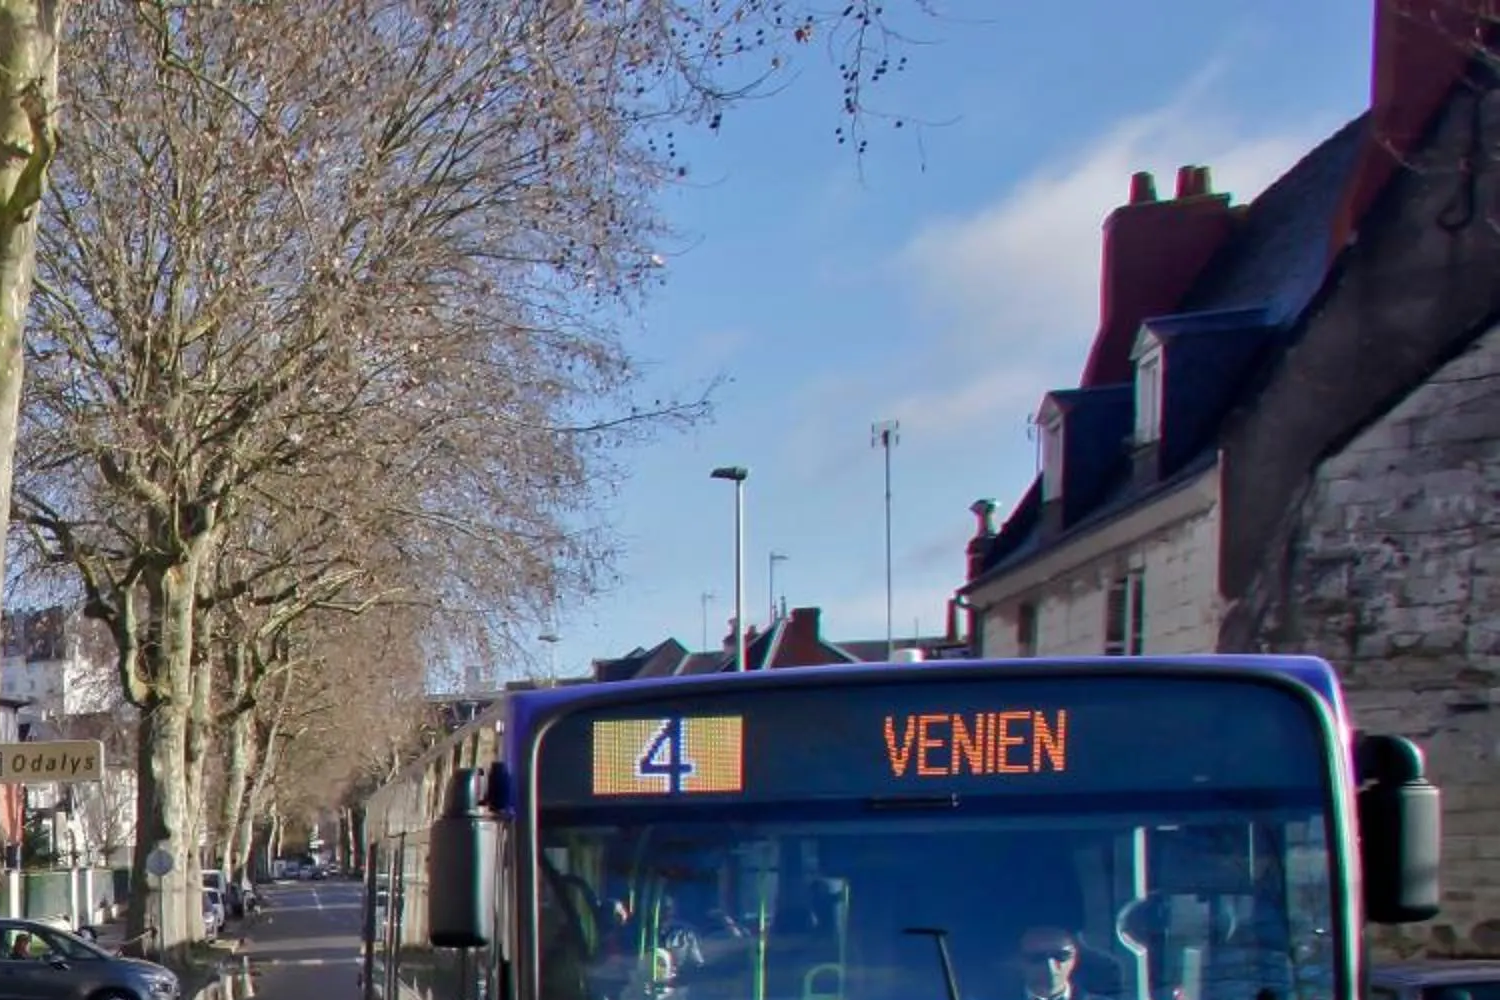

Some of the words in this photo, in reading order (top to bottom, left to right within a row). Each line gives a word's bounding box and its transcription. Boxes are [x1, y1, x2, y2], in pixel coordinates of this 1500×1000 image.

[11, 752, 95, 775] Odalys
[636, 716, 697, 794] 4
[884, 709, 1067, 777] VENIEN
